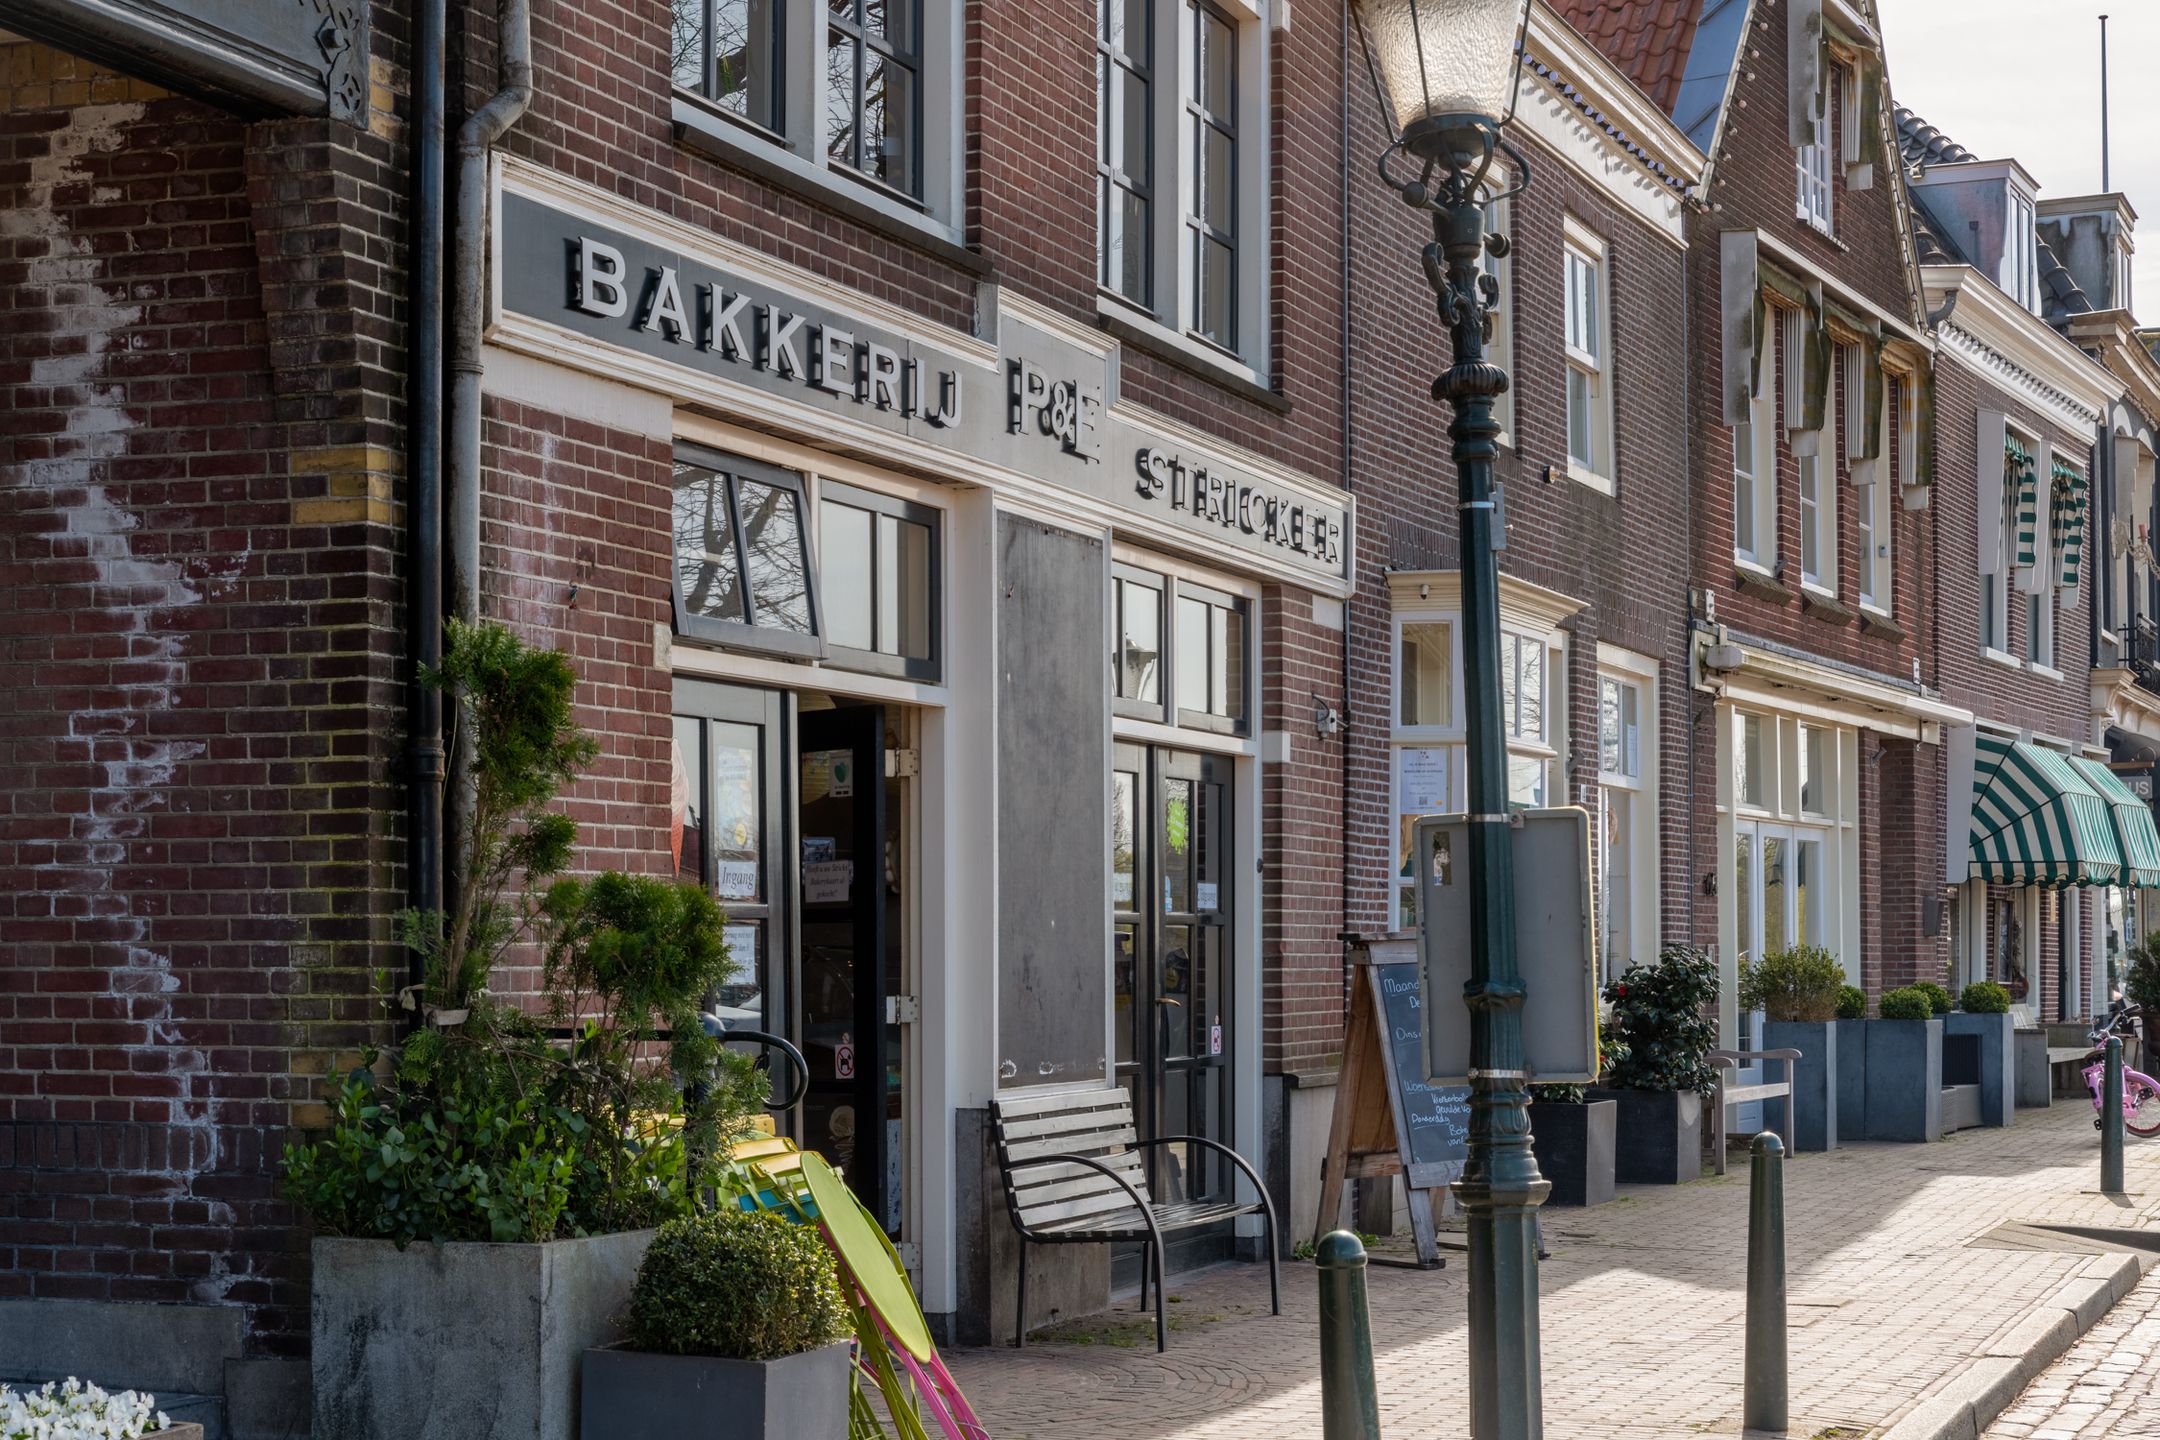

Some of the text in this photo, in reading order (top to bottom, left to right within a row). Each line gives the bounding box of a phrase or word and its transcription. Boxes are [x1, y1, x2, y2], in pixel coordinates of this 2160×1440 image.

[579, 236, 1343, 564] BAKKERIJ P&E STRICKER
[2127, 781, 2149, 795] US
[722, 867, 755, 890] Ingang
[1384, 978, 1421, 993] Maand
[1409, 995, 1421, 1009] De
[1395, 1026, 1422, 1041] Dins
